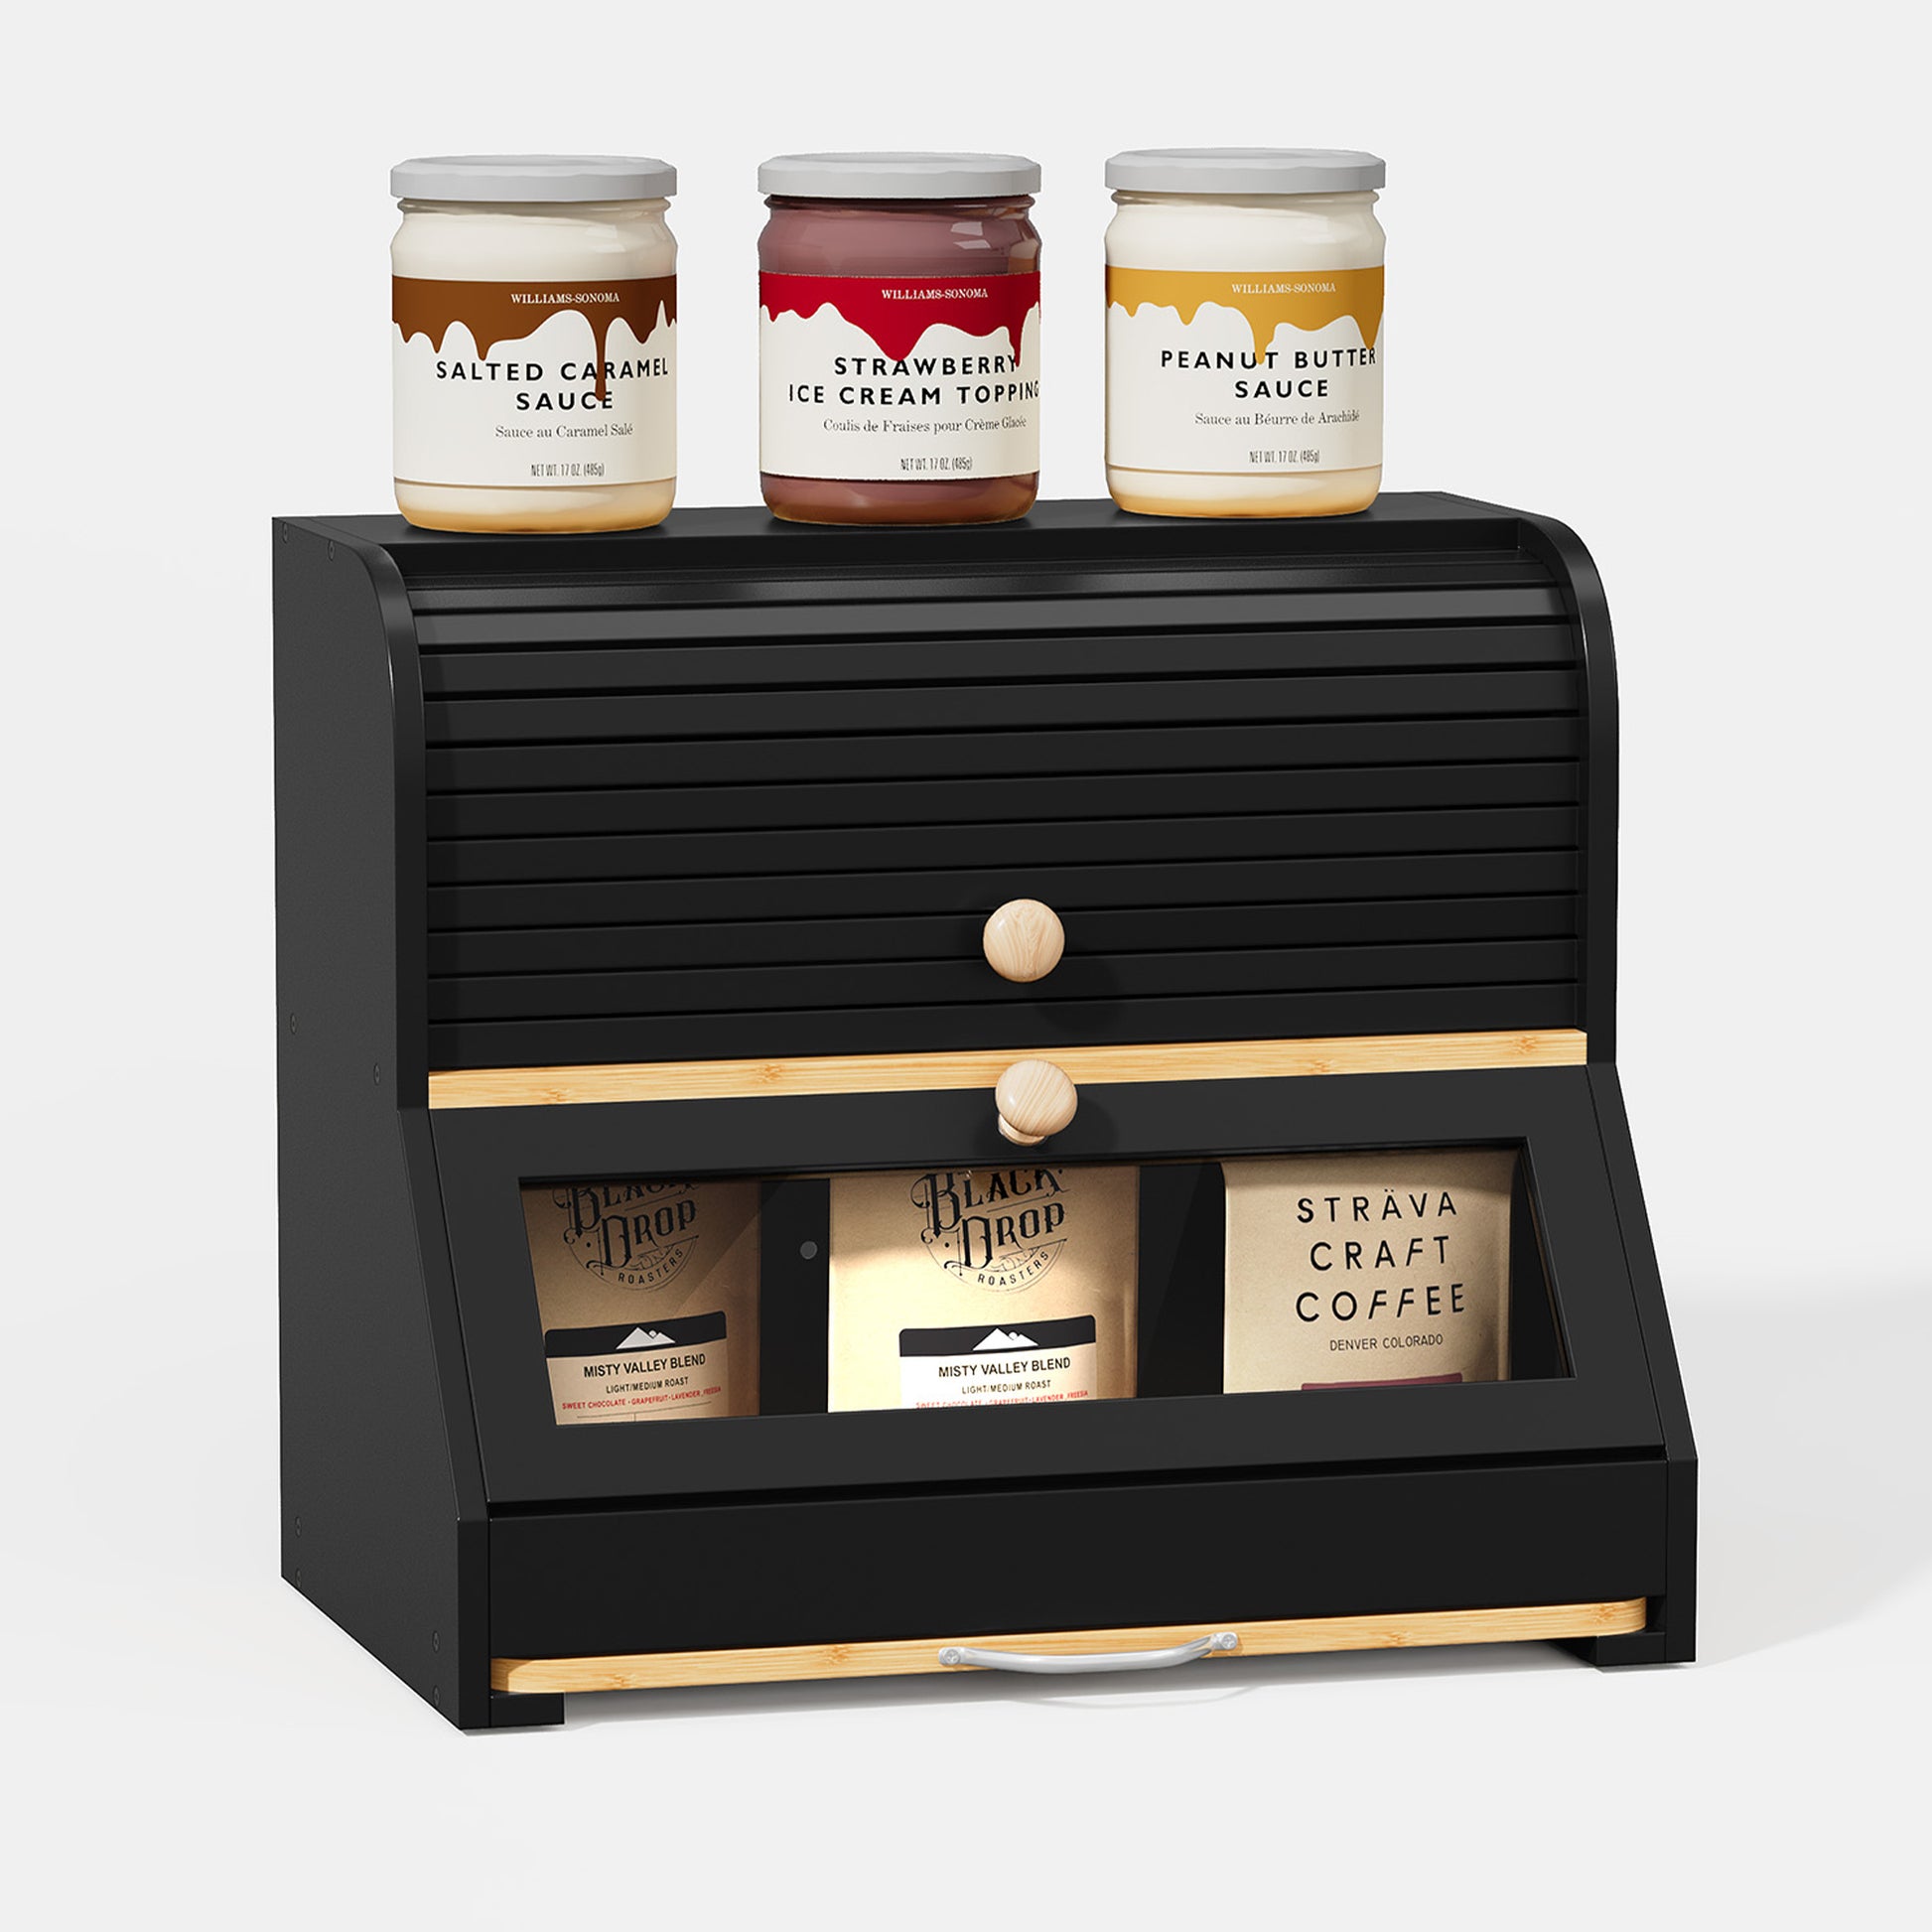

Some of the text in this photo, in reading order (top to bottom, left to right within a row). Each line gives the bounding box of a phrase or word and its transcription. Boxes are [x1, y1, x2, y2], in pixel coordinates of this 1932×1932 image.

[511, 292, 620, 304] WILLIAMS-SONOMA
[882, 288, 988, 300] WILLIAMS-SONOMA
[1231, 283, 1336, 294] WILLIAMS-SONOMA
[834, 354, 1017, 376] STRAWBERRY
[1161, 347, 1376, 369] PEANUT BUTTER
[436, 357, 668, 381] SALTED CARAMEL
[789, 380, 1039, 405] ICE CREAM TOPPING
[1235, 379, 1328, 398] SAUCE
[516, 391, 614, 411] SAUCE
[823, 418, 861, 432] Coulis
[863, 419, 879, 432] de
[883, 420, 930, 433] Fraises
[933, 421, 962, 436] pour
[964, 418, 1001, 431] Crème
[1194, 413, 1231, 425] Sauce
[1301, 412, 1315, 424] de
[495, 422, 633, 438] Sauce au Caramel Salé
[900, 458, 914, 471] NET
[929, 458, 938, 471] 17
[1249, 451, 1263, 463] NET
[1278, 450, 1287, 463] 17
[531, 465, 545, 477] NET
[561, 464, 570, 477] 17
[584, 463, 605, 477] (485g)
[1297, 1188, 1457, 1223] STRÄVA
[586, 1199, 698, 1270] DROP
[944, 1202, 1067, 1272] DROP
[1310, 1235, 1449, 1271] CRAFT
[618, 1248, 684, 1285] ROASTERS
[977, 1251, 1049, 1286] ROASTERS
[1296, 1284, 1464, 1322] COFFEE
[1329, 1333, 1444, 1351] DENVER COLORADO
[584, 1353, 706, 1378] MISTY VALLEY BLEND
[938, 1356, 1071, 1378] MISTY VALLEY BLEND
[606, 1376, 689, 1394] LIGHT/MEDIUM ROAST
[961, 1380, 1051, 1395] LIGHT/MEDIUM ROAST
[562, 1401, 586, 1410] SWEET
[588, 1398, 626, 1409] CHOCOLATE
